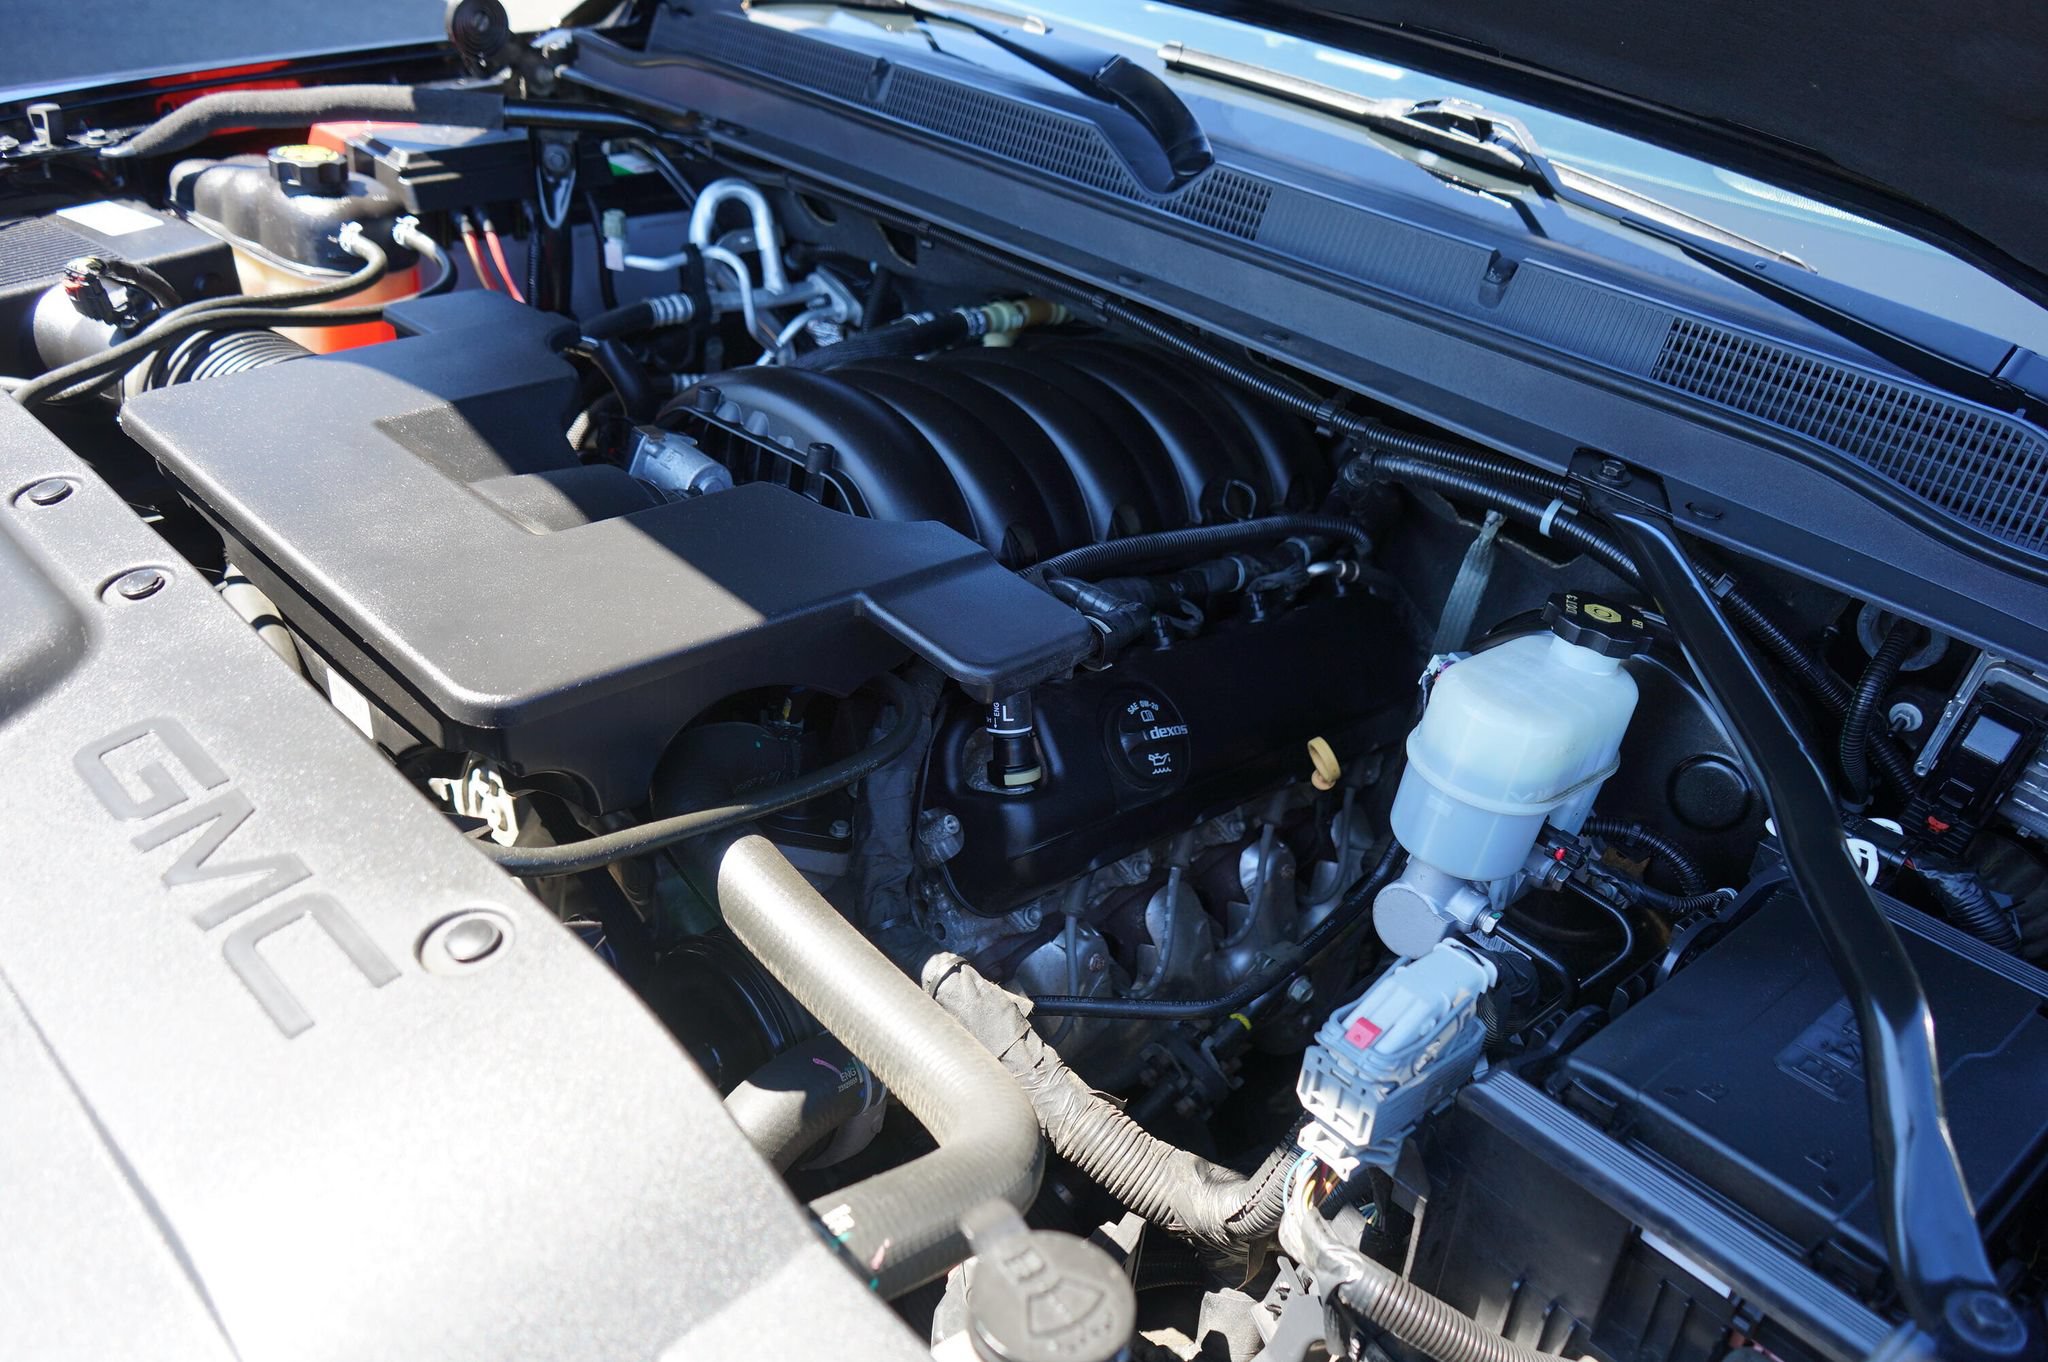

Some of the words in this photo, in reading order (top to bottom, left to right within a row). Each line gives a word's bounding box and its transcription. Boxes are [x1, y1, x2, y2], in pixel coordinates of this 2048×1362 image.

[992, 701, 1000, 716] ENG
[1001, 704, 1015, 721] L
[1127, 701, 1140, 715] SAE
[1149, 724, 1189, 740] dexos
[72, 715, 402, 1040] GMC
[840, 1067, 857, 1082] ENG
